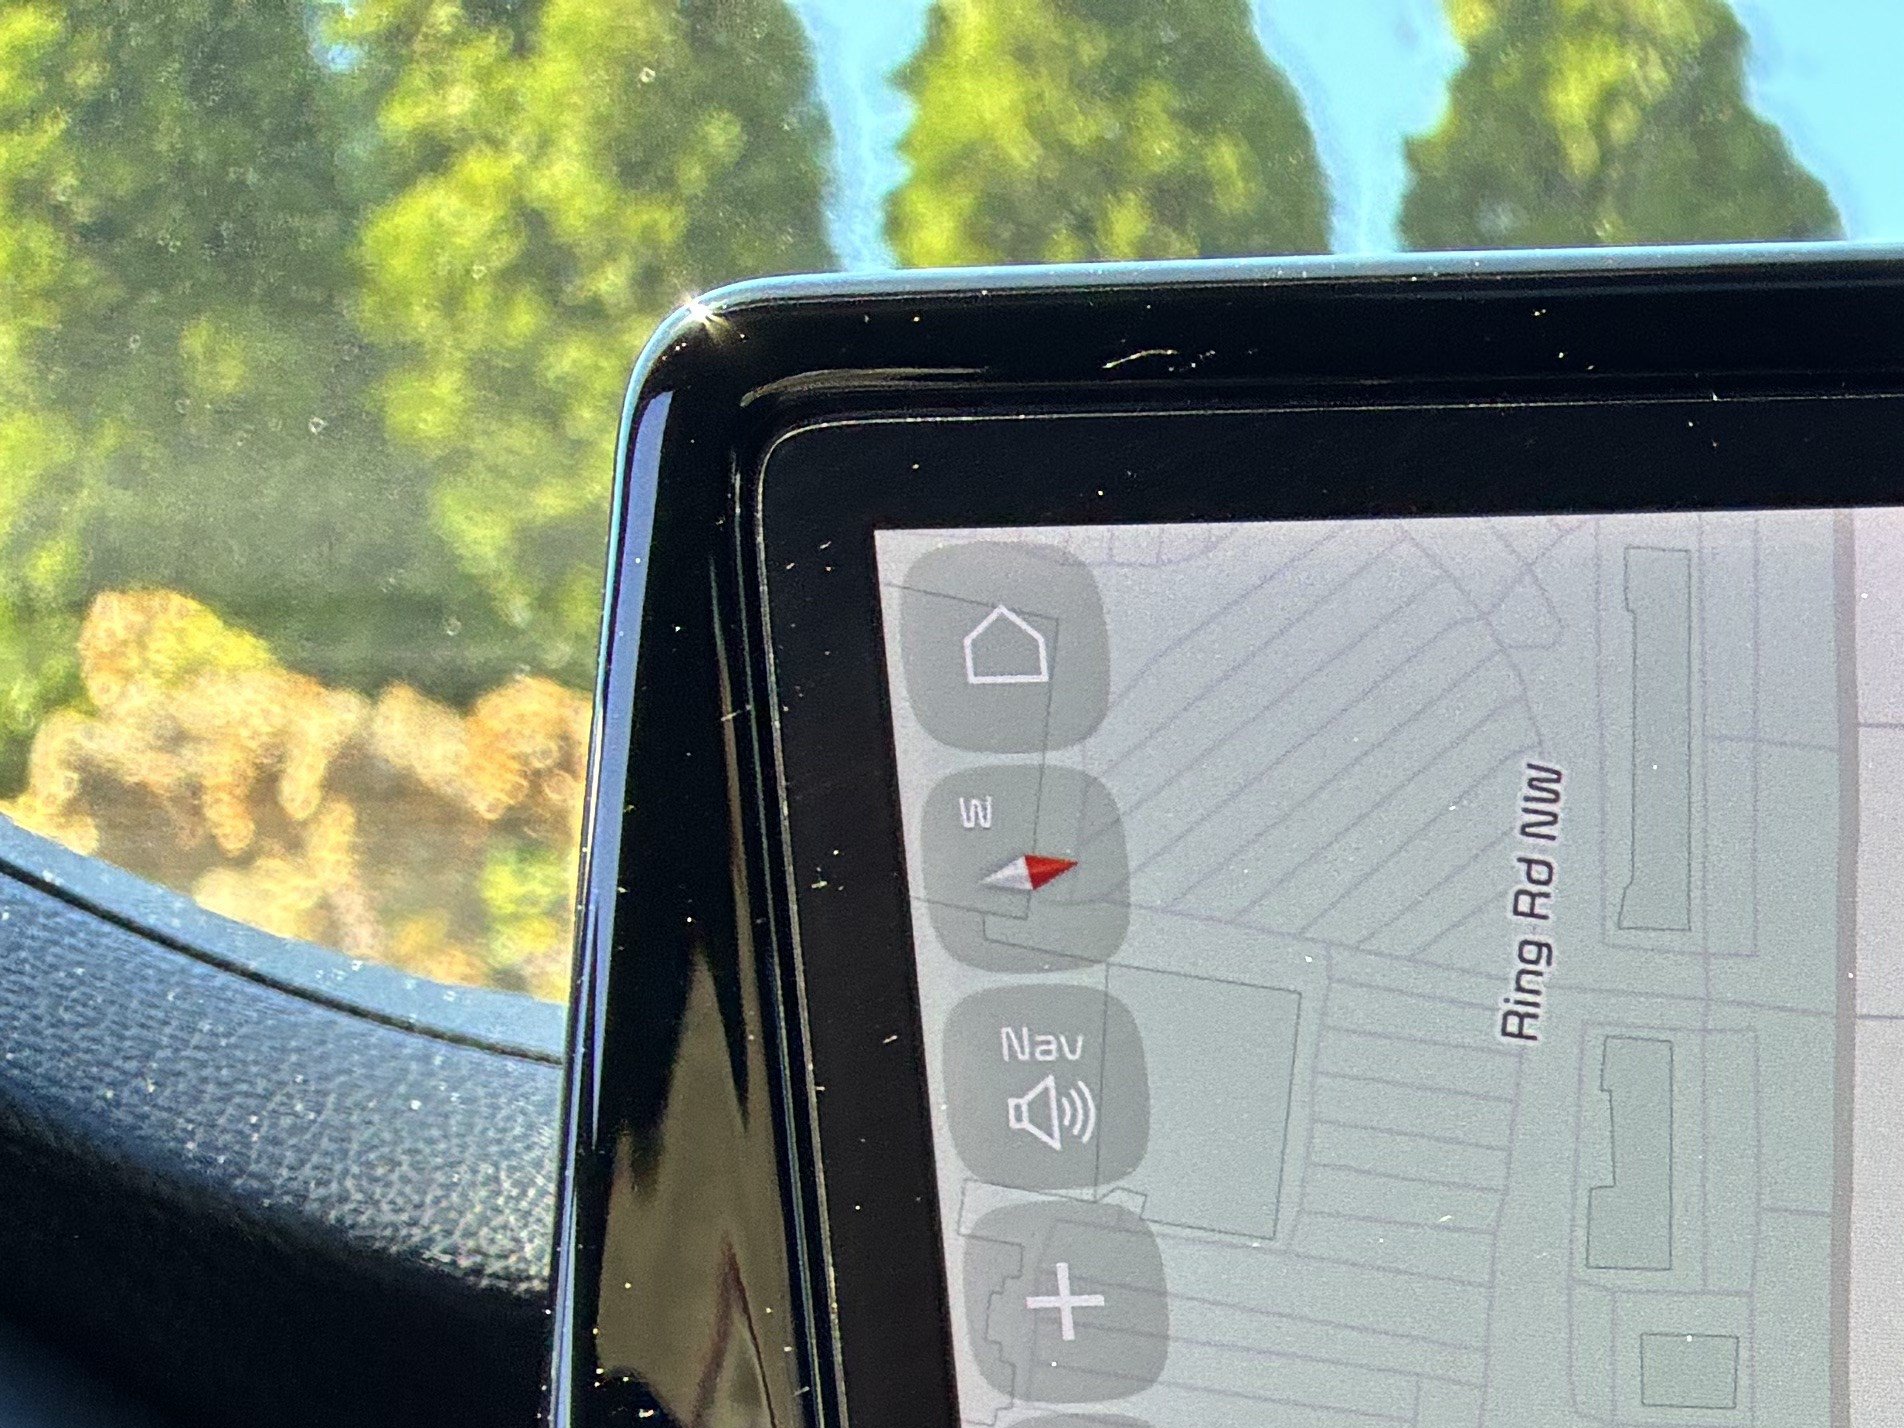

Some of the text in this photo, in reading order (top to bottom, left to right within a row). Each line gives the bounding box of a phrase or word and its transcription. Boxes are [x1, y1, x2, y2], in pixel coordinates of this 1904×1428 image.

[957, 795, 994, 830] W
[1499, 762, 1564, 1042] Ring Rd NW
[999, 1025, 1085, 1063] Nav
